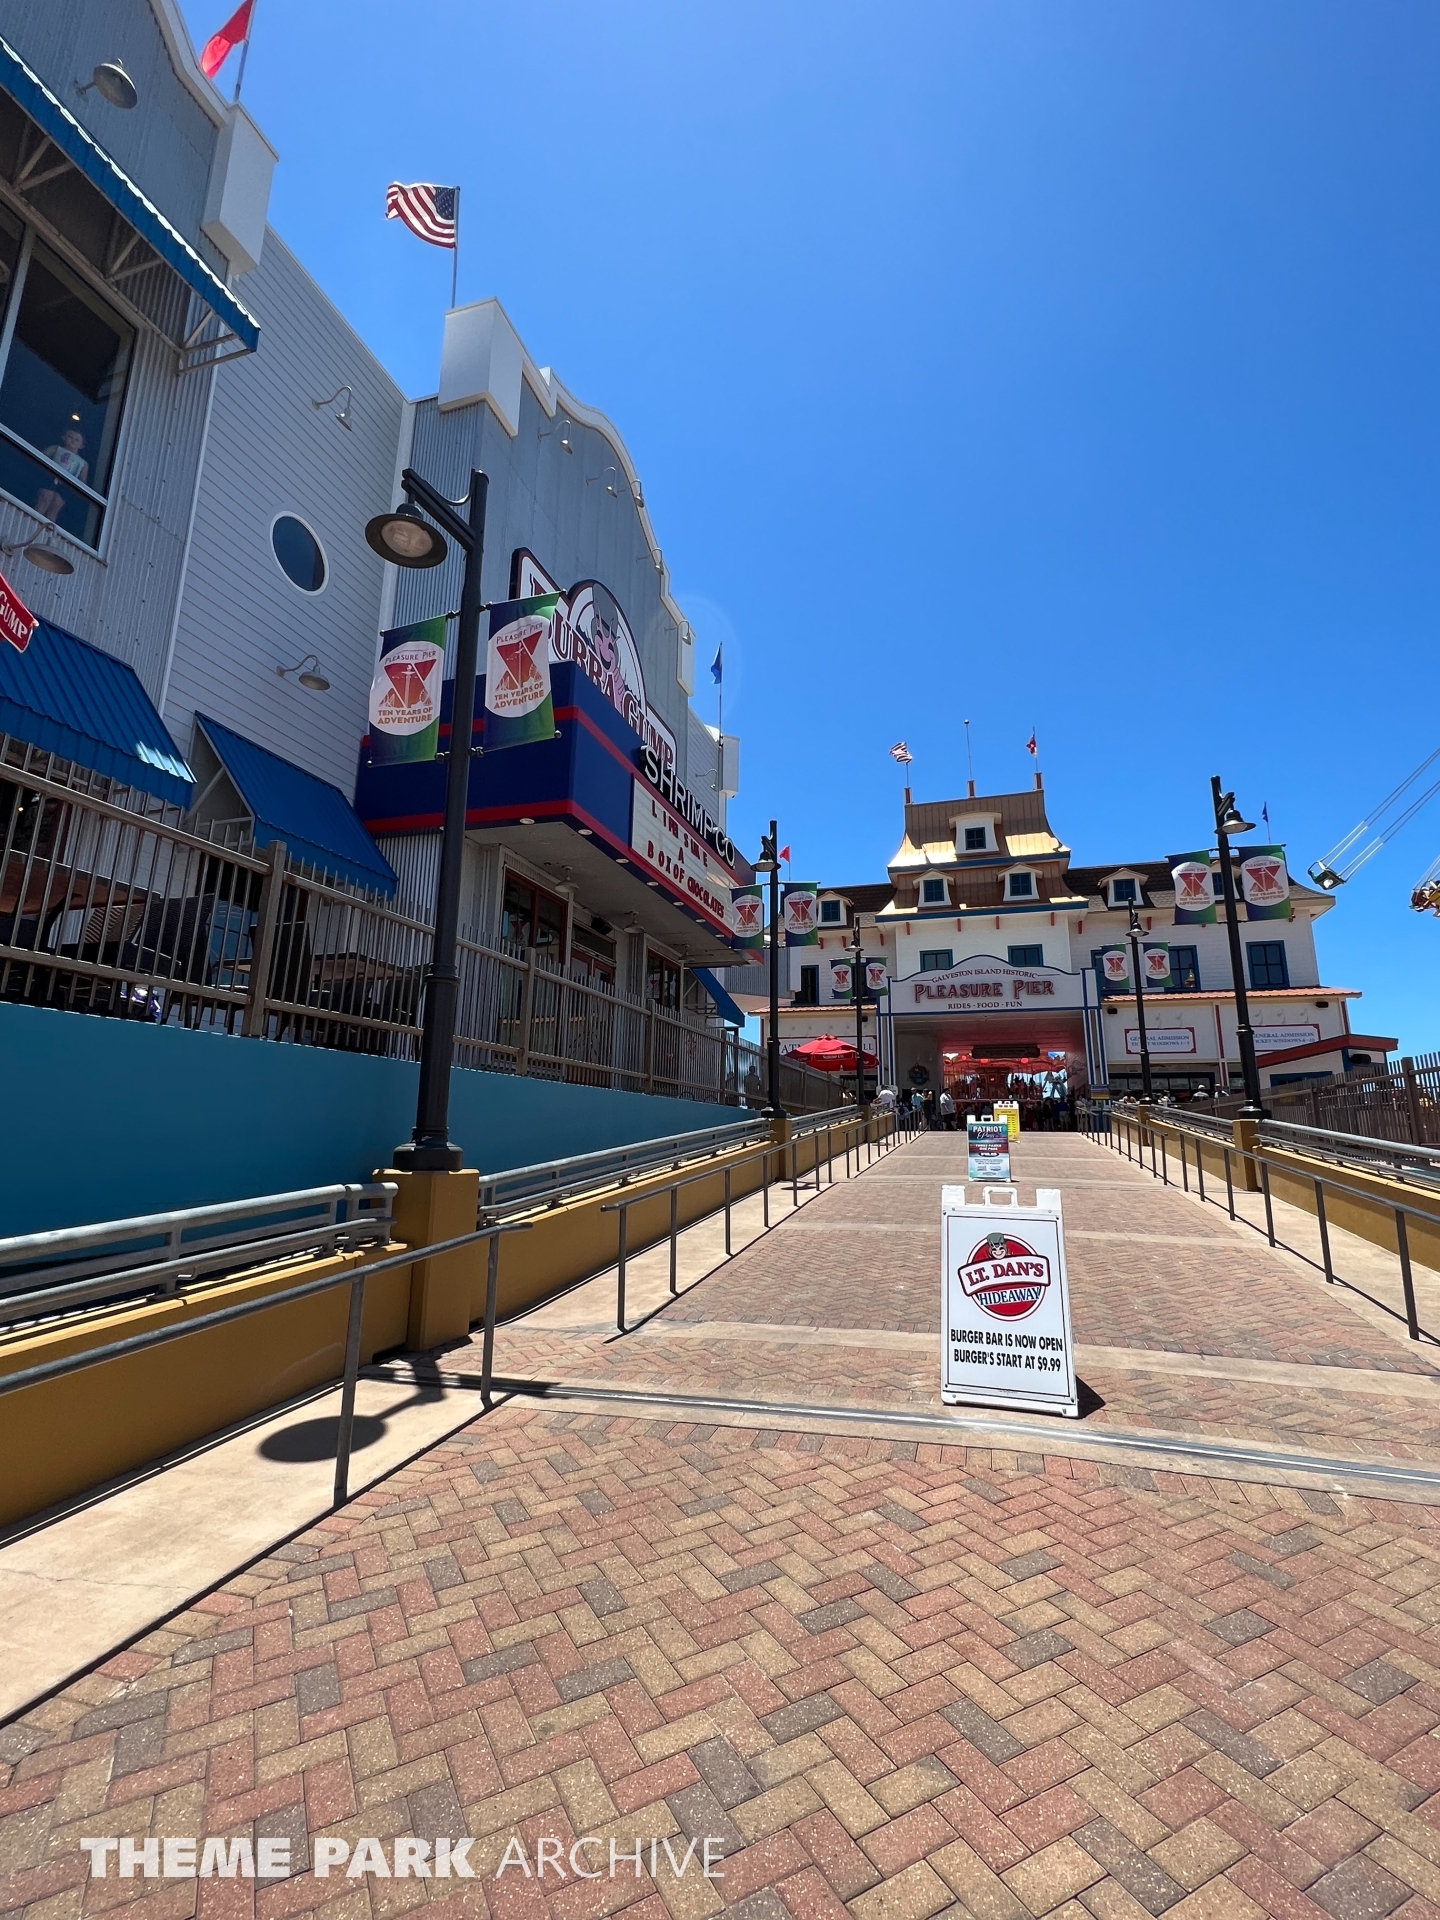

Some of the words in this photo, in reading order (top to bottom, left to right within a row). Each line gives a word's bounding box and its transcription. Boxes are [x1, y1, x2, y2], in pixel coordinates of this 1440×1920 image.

[496, 630, 528, 643] PLEASURE
[529, 622, 543, 634] PIER
[385, 653, 419, 664] PLEASURE
[422, 650, 437, 660] PIER
[493, 690, 545, 709] ADVENTURE
[494, 692, 509, 701] TEN
[510, 684, 533, 698] YEARS
[534, 681, 544, 690] OF
[378, 714, 432, 724] ADVENTURE
[395, 708, 421, 716] YEARS
[422, 706, 433, 715] OF
[642, 745, 714, 840] SHRIMP
[648, 840, 671, 874] BOX
[673, 864, 685, 883] OF
[678, 847, 684, 864] A
[932, 970, 973, 983] GALVESTON
[974, 968, 1002, 977] ISLAND
[1002, 969, 1038, 979] HISTORIC
[914, 982, 1004, 1003] PLEASURE
[1013, 980, 1054, 1000] PIER
[973, 1125, 1003, 1133] PATRIOT
[966, 1268, 990, 1286] LT.
[991, 1262, 1044, 1278] DAN'S
[978, 1287, 1041, 1306] HIDEAWAY
[950, 1328, 984, 1345] BURGER
[986, 1332, 1003, 1346] BAR
[1005, 1333, 1013, 1347] IS
[1015, 1334, 1036, 1349] NOW
[1039, 1336, 1063, 1352] OPEN
[954, 1349, 995, 1365] BURGER'S
[996, 1353, 1023, 1368] START
[1024, 1355, 1036, 1370] AT
[1037, 1357, 1061, 1372] $9.99
